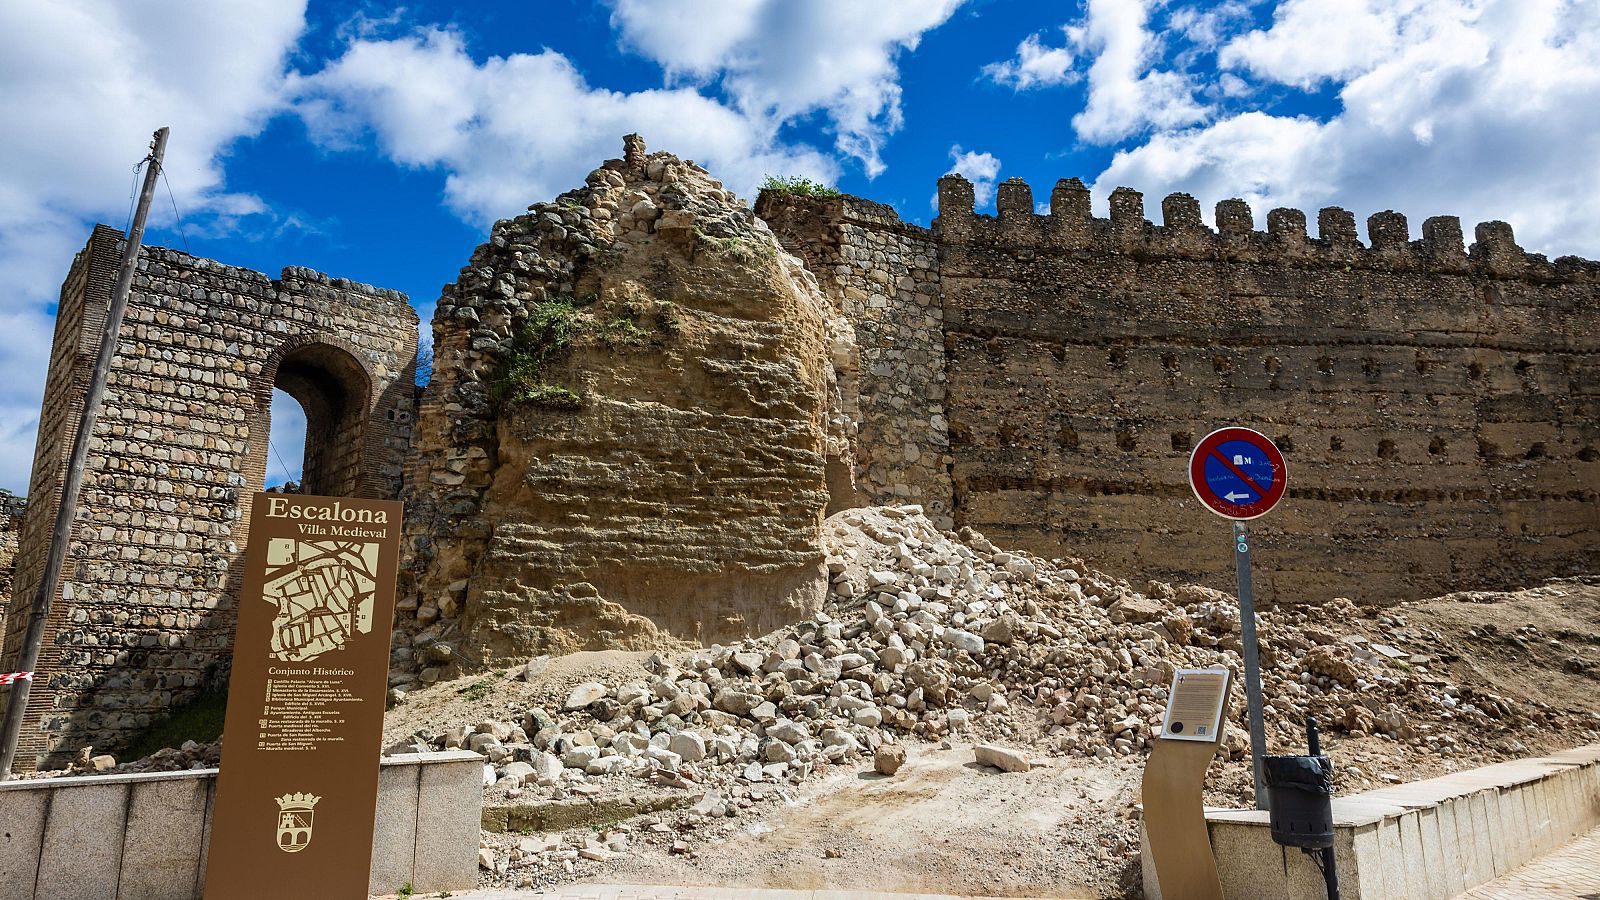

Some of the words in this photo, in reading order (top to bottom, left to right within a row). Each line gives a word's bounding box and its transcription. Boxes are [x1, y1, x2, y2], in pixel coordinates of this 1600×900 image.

[266, 498, 388, 523] Escalona
[298, 524, 326, 535] Villa
[330, 526, 386, 538] Medieval
[269, 667, 310, 676] Conjunto
[313, 667, 354, 676] Histórico
